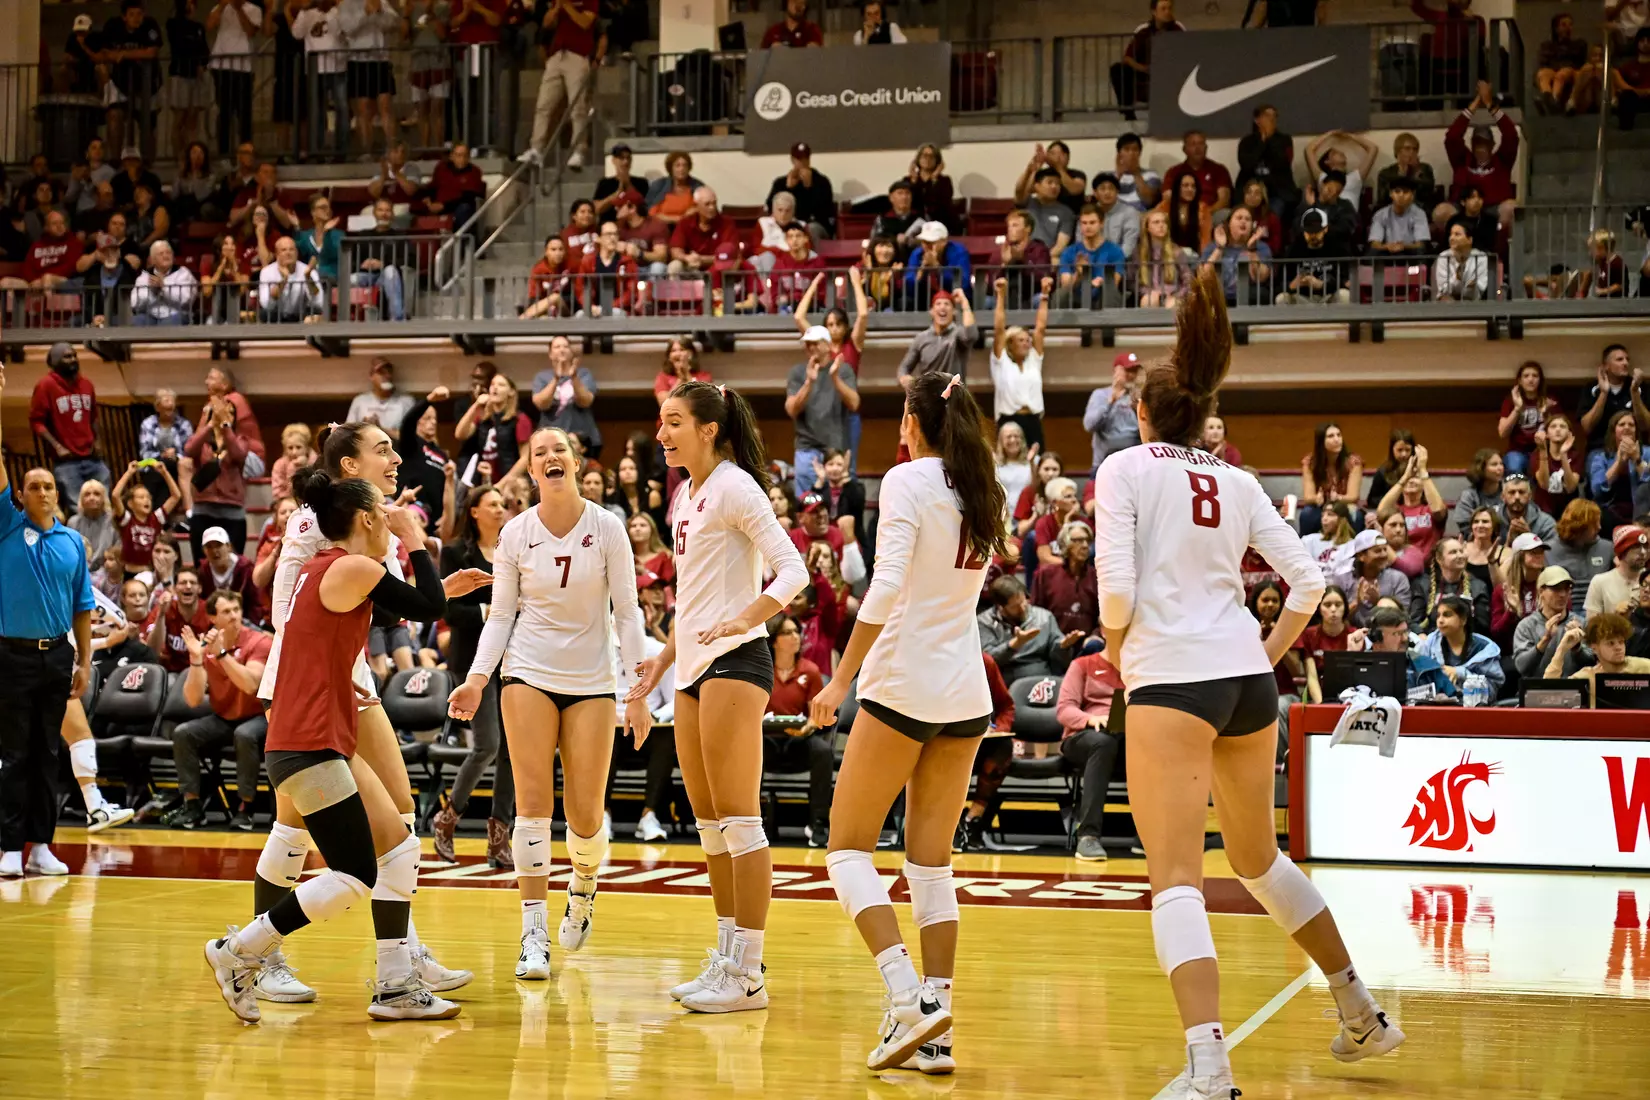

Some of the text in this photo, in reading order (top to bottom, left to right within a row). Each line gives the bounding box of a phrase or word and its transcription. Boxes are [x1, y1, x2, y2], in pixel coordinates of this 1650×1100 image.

[796, 86, 941, 108] Gesa Credit Union
[1184, 469, 1221, 529] 8
[675, 520, 689, 556] 15
[554, 555, 572, 589] 7
